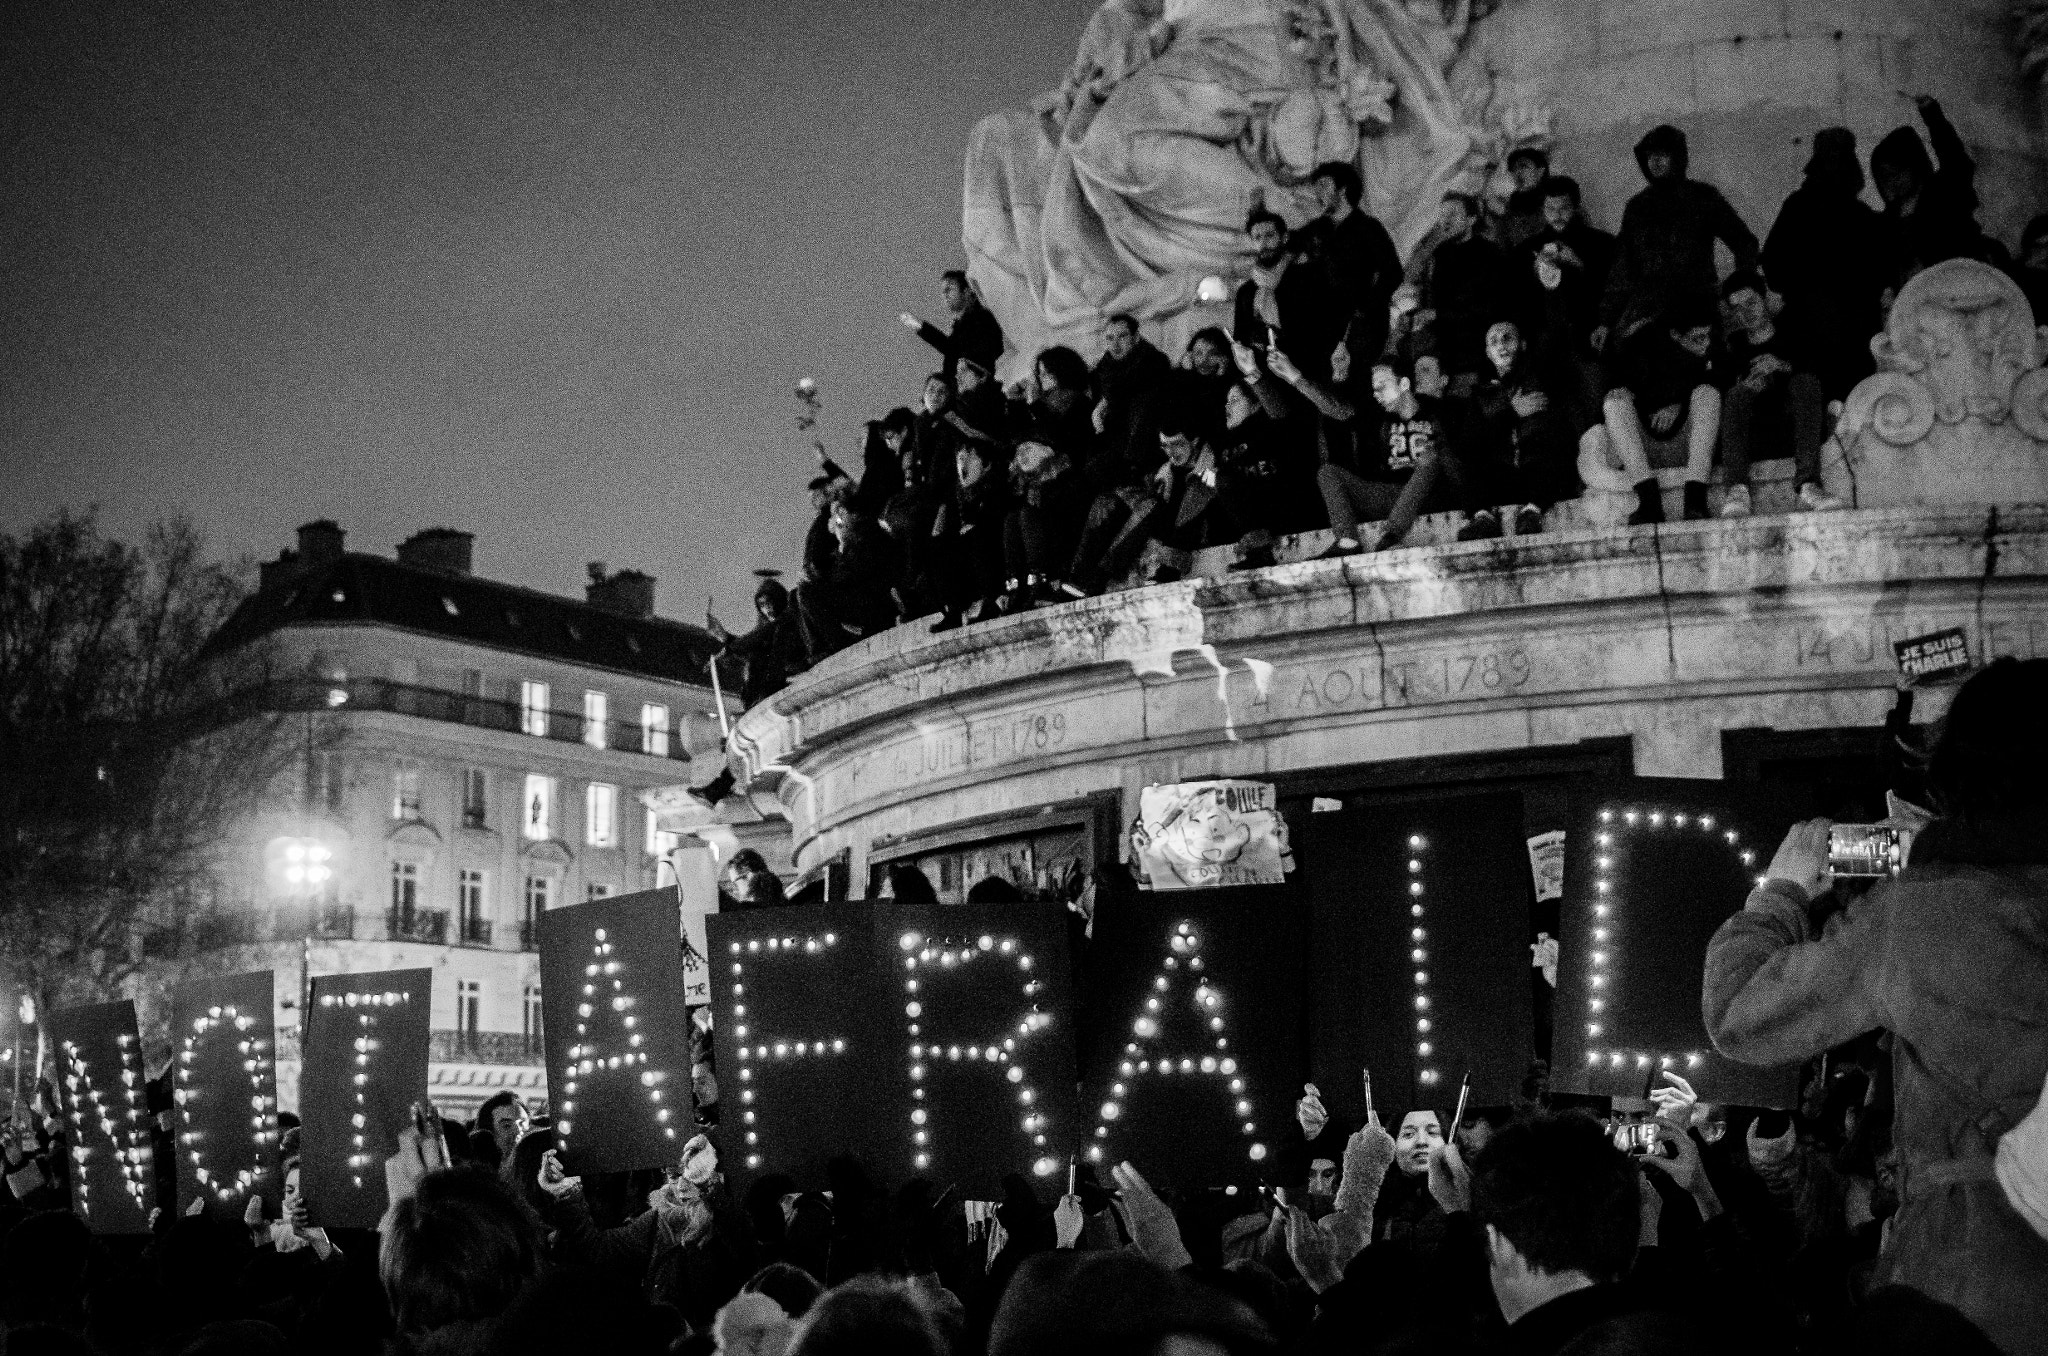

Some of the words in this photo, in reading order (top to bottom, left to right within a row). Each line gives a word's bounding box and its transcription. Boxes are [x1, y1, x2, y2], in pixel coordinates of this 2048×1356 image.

[1899, 644, 1922, 661] JE
[1922, 634, 1963, 655] SUIS
[1902, 647, 1969, 675] CHARLIE
[1296, 661, 1418, 709] AOUT
[1443, 648, 1531, 695] 1789
[1010, 711, 1068, 755] 1789
[63, 990, 410, 1216] NOT
